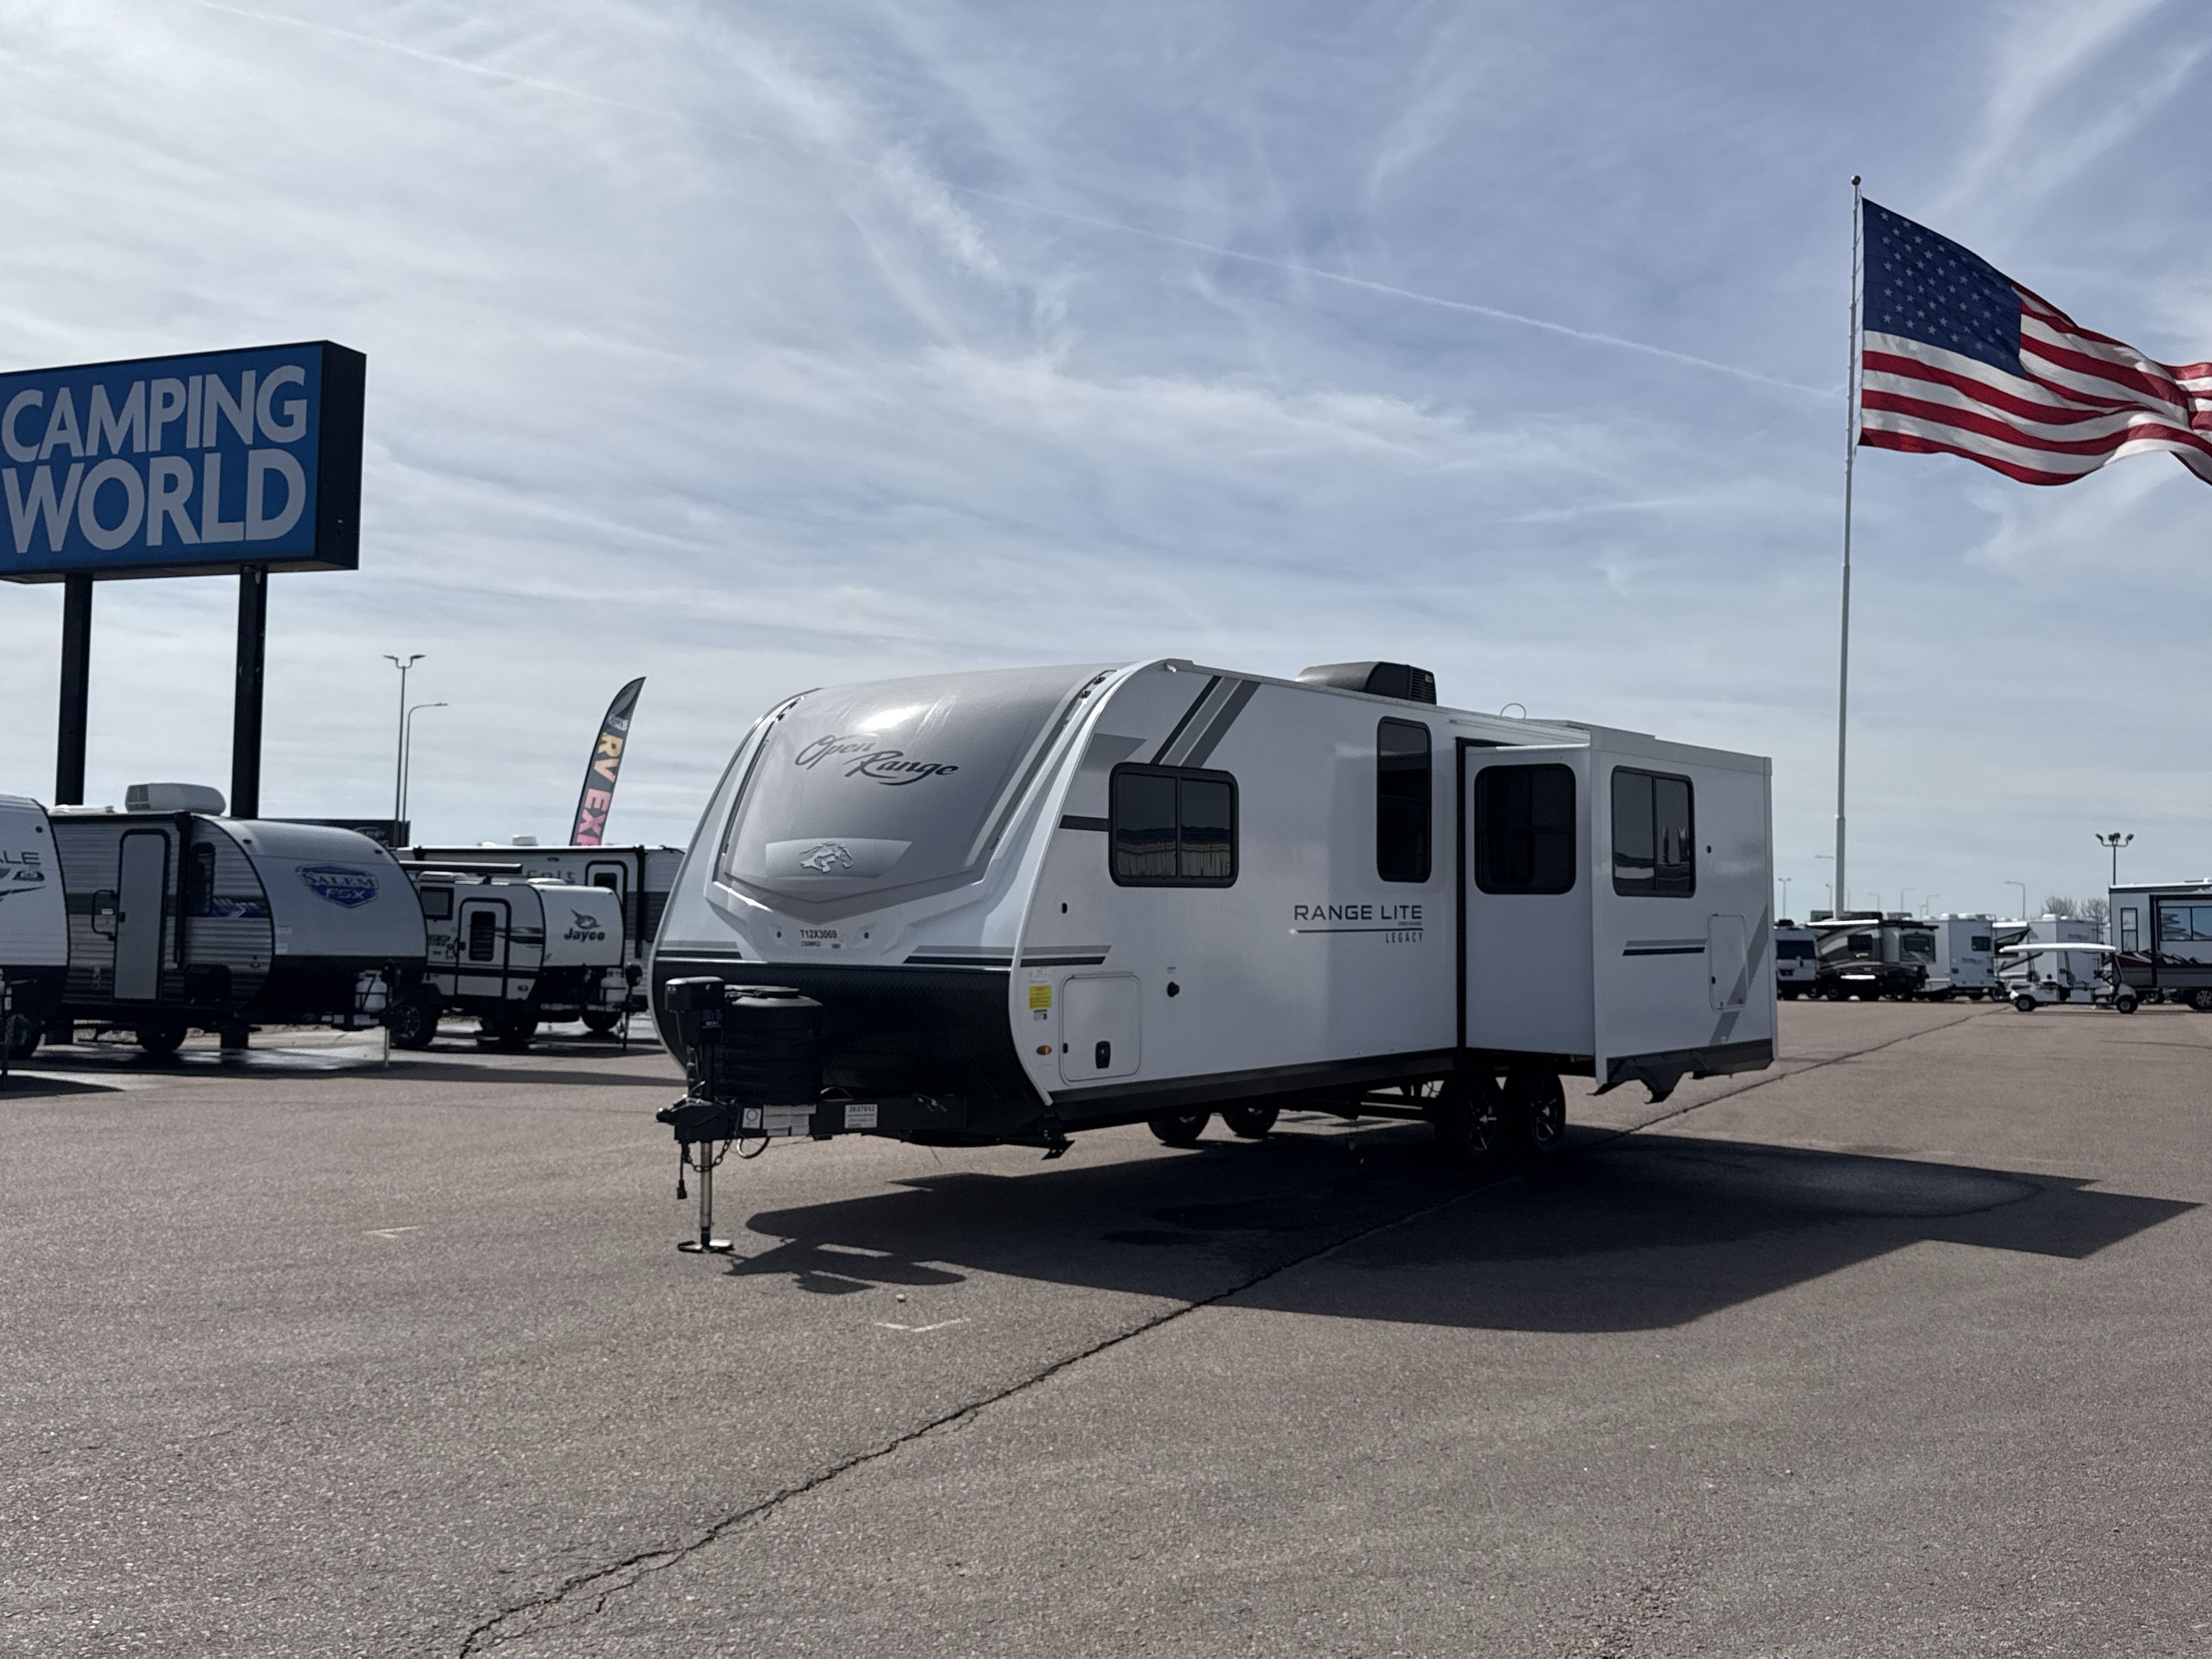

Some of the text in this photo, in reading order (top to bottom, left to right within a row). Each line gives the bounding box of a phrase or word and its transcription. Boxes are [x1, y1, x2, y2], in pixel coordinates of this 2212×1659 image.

[1, 365, 307, 463] CAMPING
[1, 448, 307, 554] WORLD
[594, 732, 623, 783] RV
[795, 734, 877, 770] Open
[843, 751, 959, 786] Range
[0, 850, 41, 865] LE
[302, 872, 375, 889] SALEM
[1294, 905, 1422, 920] RANGE LITE
[563, 928, 606, 942] Jayco
[1385, 932, 1423, 943] LEGACY
